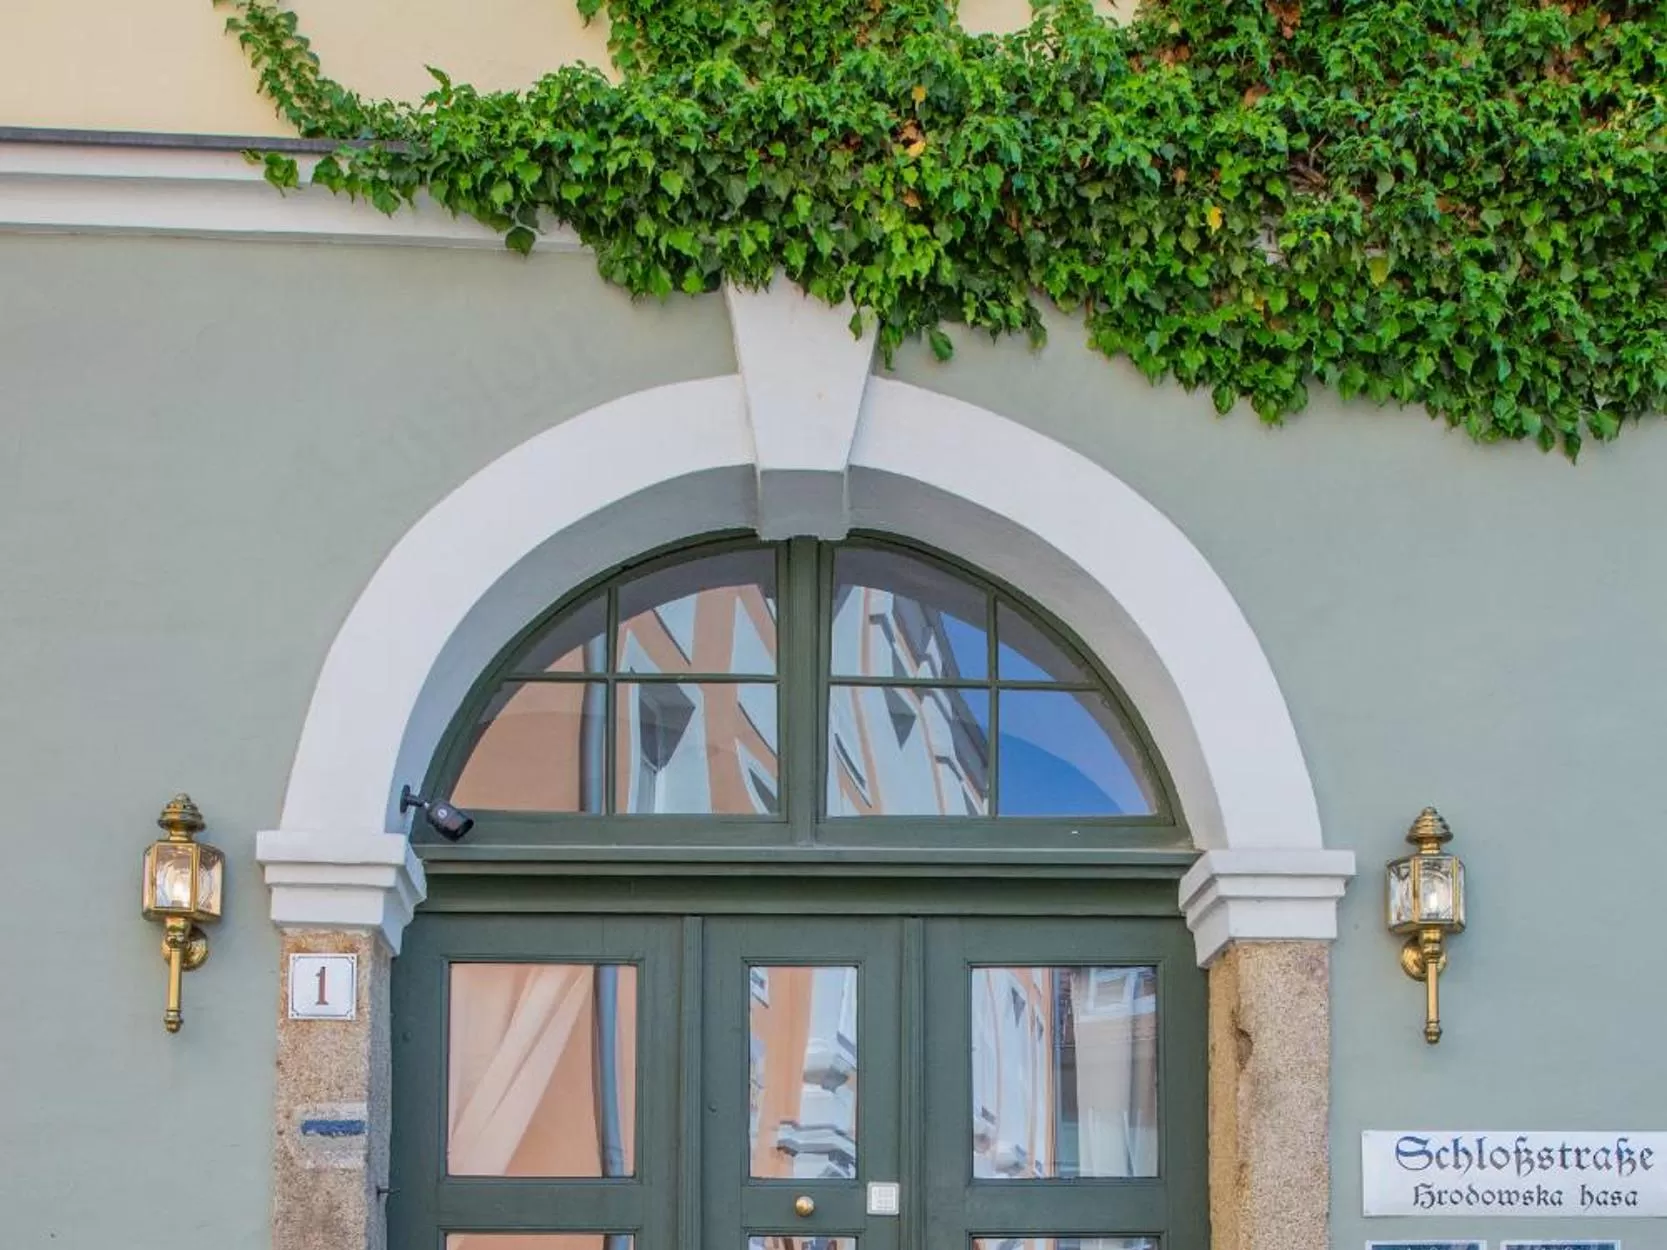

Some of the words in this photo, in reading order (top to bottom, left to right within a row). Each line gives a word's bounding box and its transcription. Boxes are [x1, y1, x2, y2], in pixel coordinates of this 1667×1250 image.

[314, 965, 330, 1006] 1
[1395, 1135, 1655, 1178] Schloßstraße
[1412, 1182, 1564, 1209] Hrodowska
[1579, 1183, 1639, 1210] hasa
